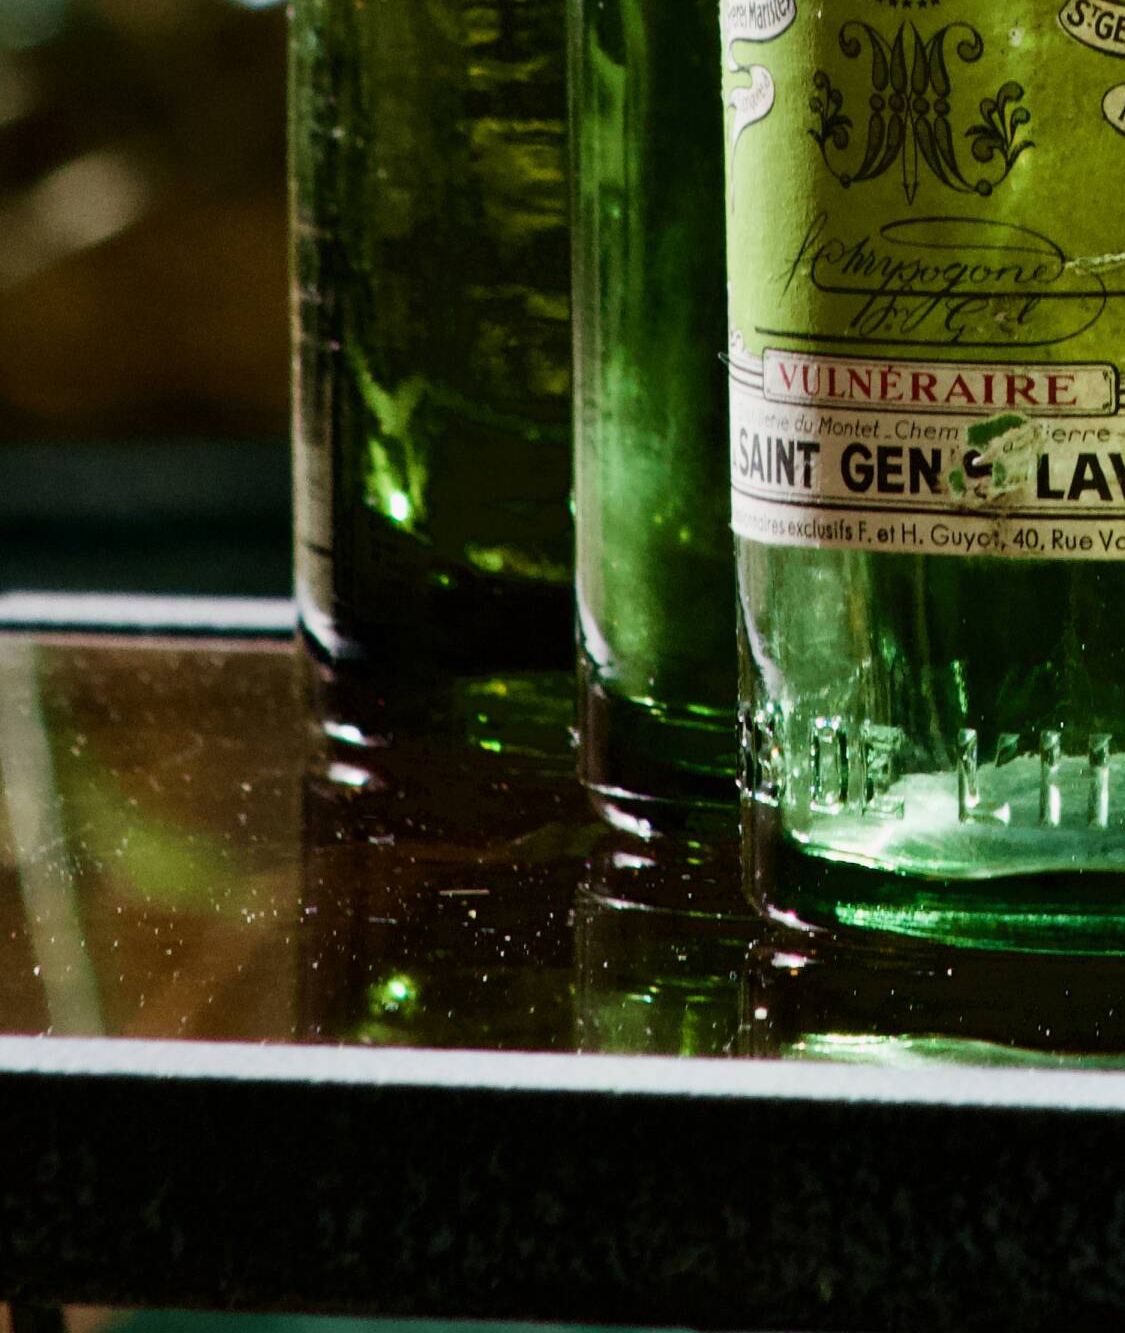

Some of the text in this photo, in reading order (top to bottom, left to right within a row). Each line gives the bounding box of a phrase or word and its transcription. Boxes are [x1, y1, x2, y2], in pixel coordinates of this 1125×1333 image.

[778, 363, 1078, 407] VULNÉRAIRE
[794, 414, 814, 434] du
[818, 416, 881, 439] Montet
[738, 427, 821, 490] SAINT
[788, 518, 853, 540] exclusifs
[858, 520, 872, 541] F.
[877, 523, 896, 543] et
[902, 523, 924, 545] H.
[1012, 527, 1045, 552] 40,
[1051, 530, 1093, 552] Rue
